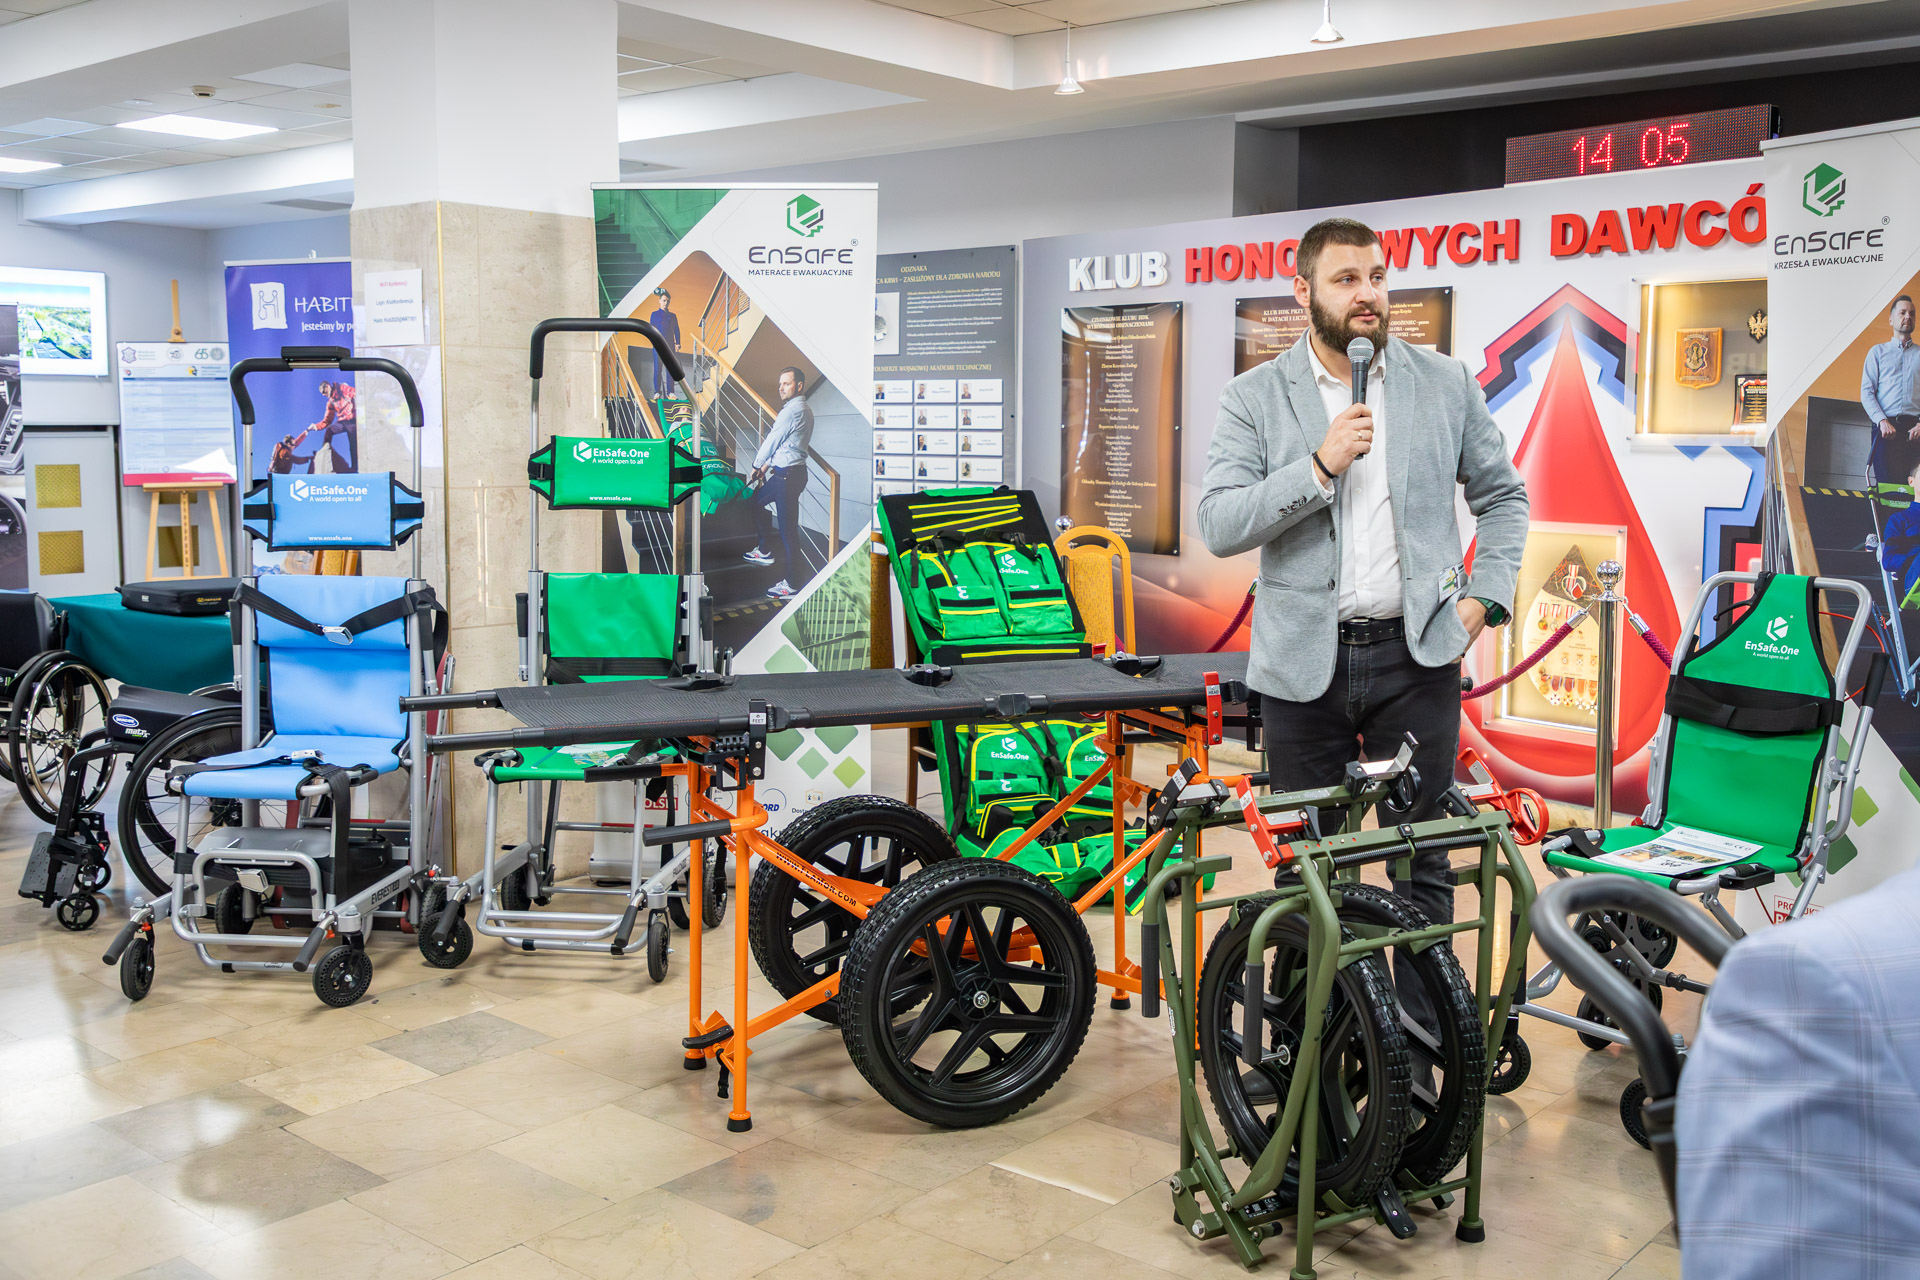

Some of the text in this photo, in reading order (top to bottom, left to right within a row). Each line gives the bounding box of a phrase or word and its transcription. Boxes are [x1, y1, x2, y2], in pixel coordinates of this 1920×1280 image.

[1572, 123, 1690, 174] 14 05
[1774, 253, 1884, 270] KRZESŁA EWAKUACYJNE
[900, 265, 928, 273] ODZNAKA
[1069, 251, 1168, 292] KLUB
[936, 273, 948, 281] DLA
[301, 320, 335, 333] Jesteśmy
[336, 320, 346, 333] by
[593, 447, 650, 458] EnSafe.One
[310, 485, 368, 495] EnSafe.One
[1745, 640, 1800, 656] EnSafe.One
[990, 751, 1030, 761] EnSafe.One
